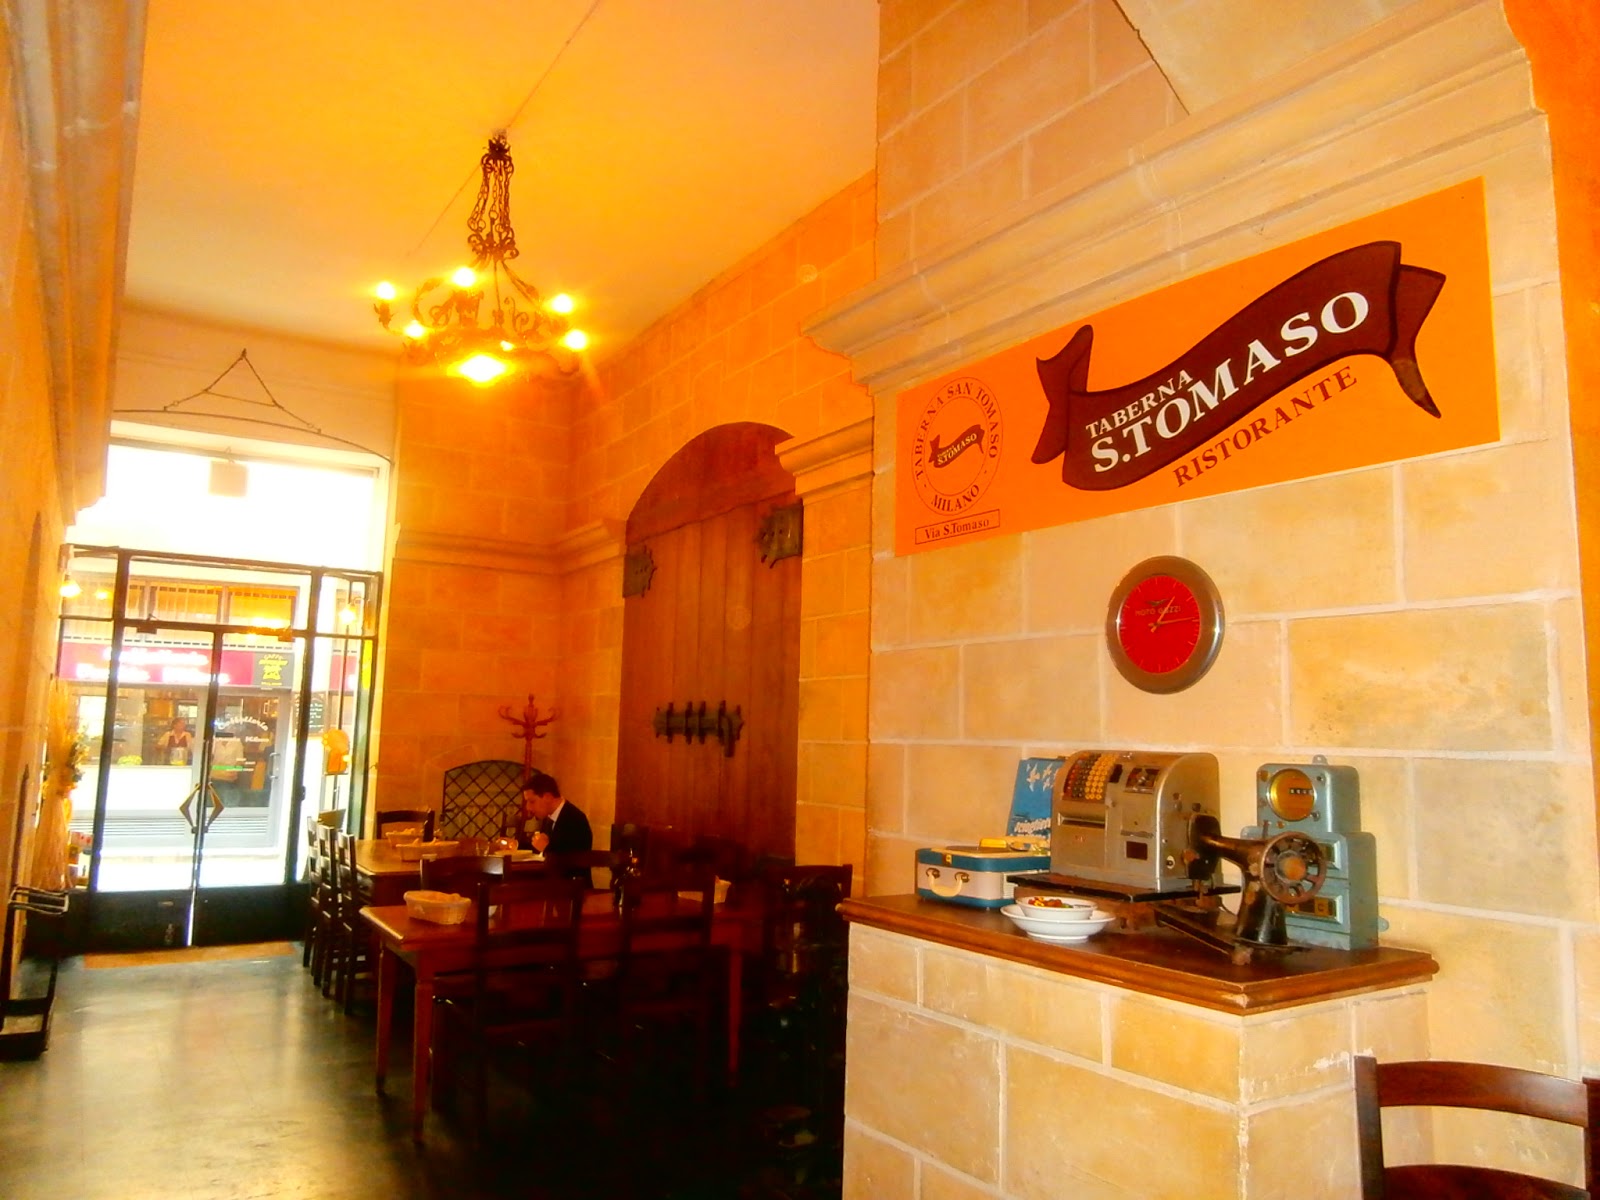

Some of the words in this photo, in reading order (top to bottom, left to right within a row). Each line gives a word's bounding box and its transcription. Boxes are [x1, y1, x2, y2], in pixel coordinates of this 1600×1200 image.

[1085, 369, 1194, 439] TABERNA
[1089, 291, 1370, 474] S.TOMASO
[914, 396, 945, 480] TABERNA
[946, 381, 974, 397] SAN
[974, 386, 1000, 459] TOMASO
[1171, 365, 1358, 488] RISTORANTE
[924, 528, 941, 540] Via
[943, 517, 990, 536] S.Tomaso
[931, 484, 980, 512] MILANO
[1134, 607, 1156, 617] MOTO
